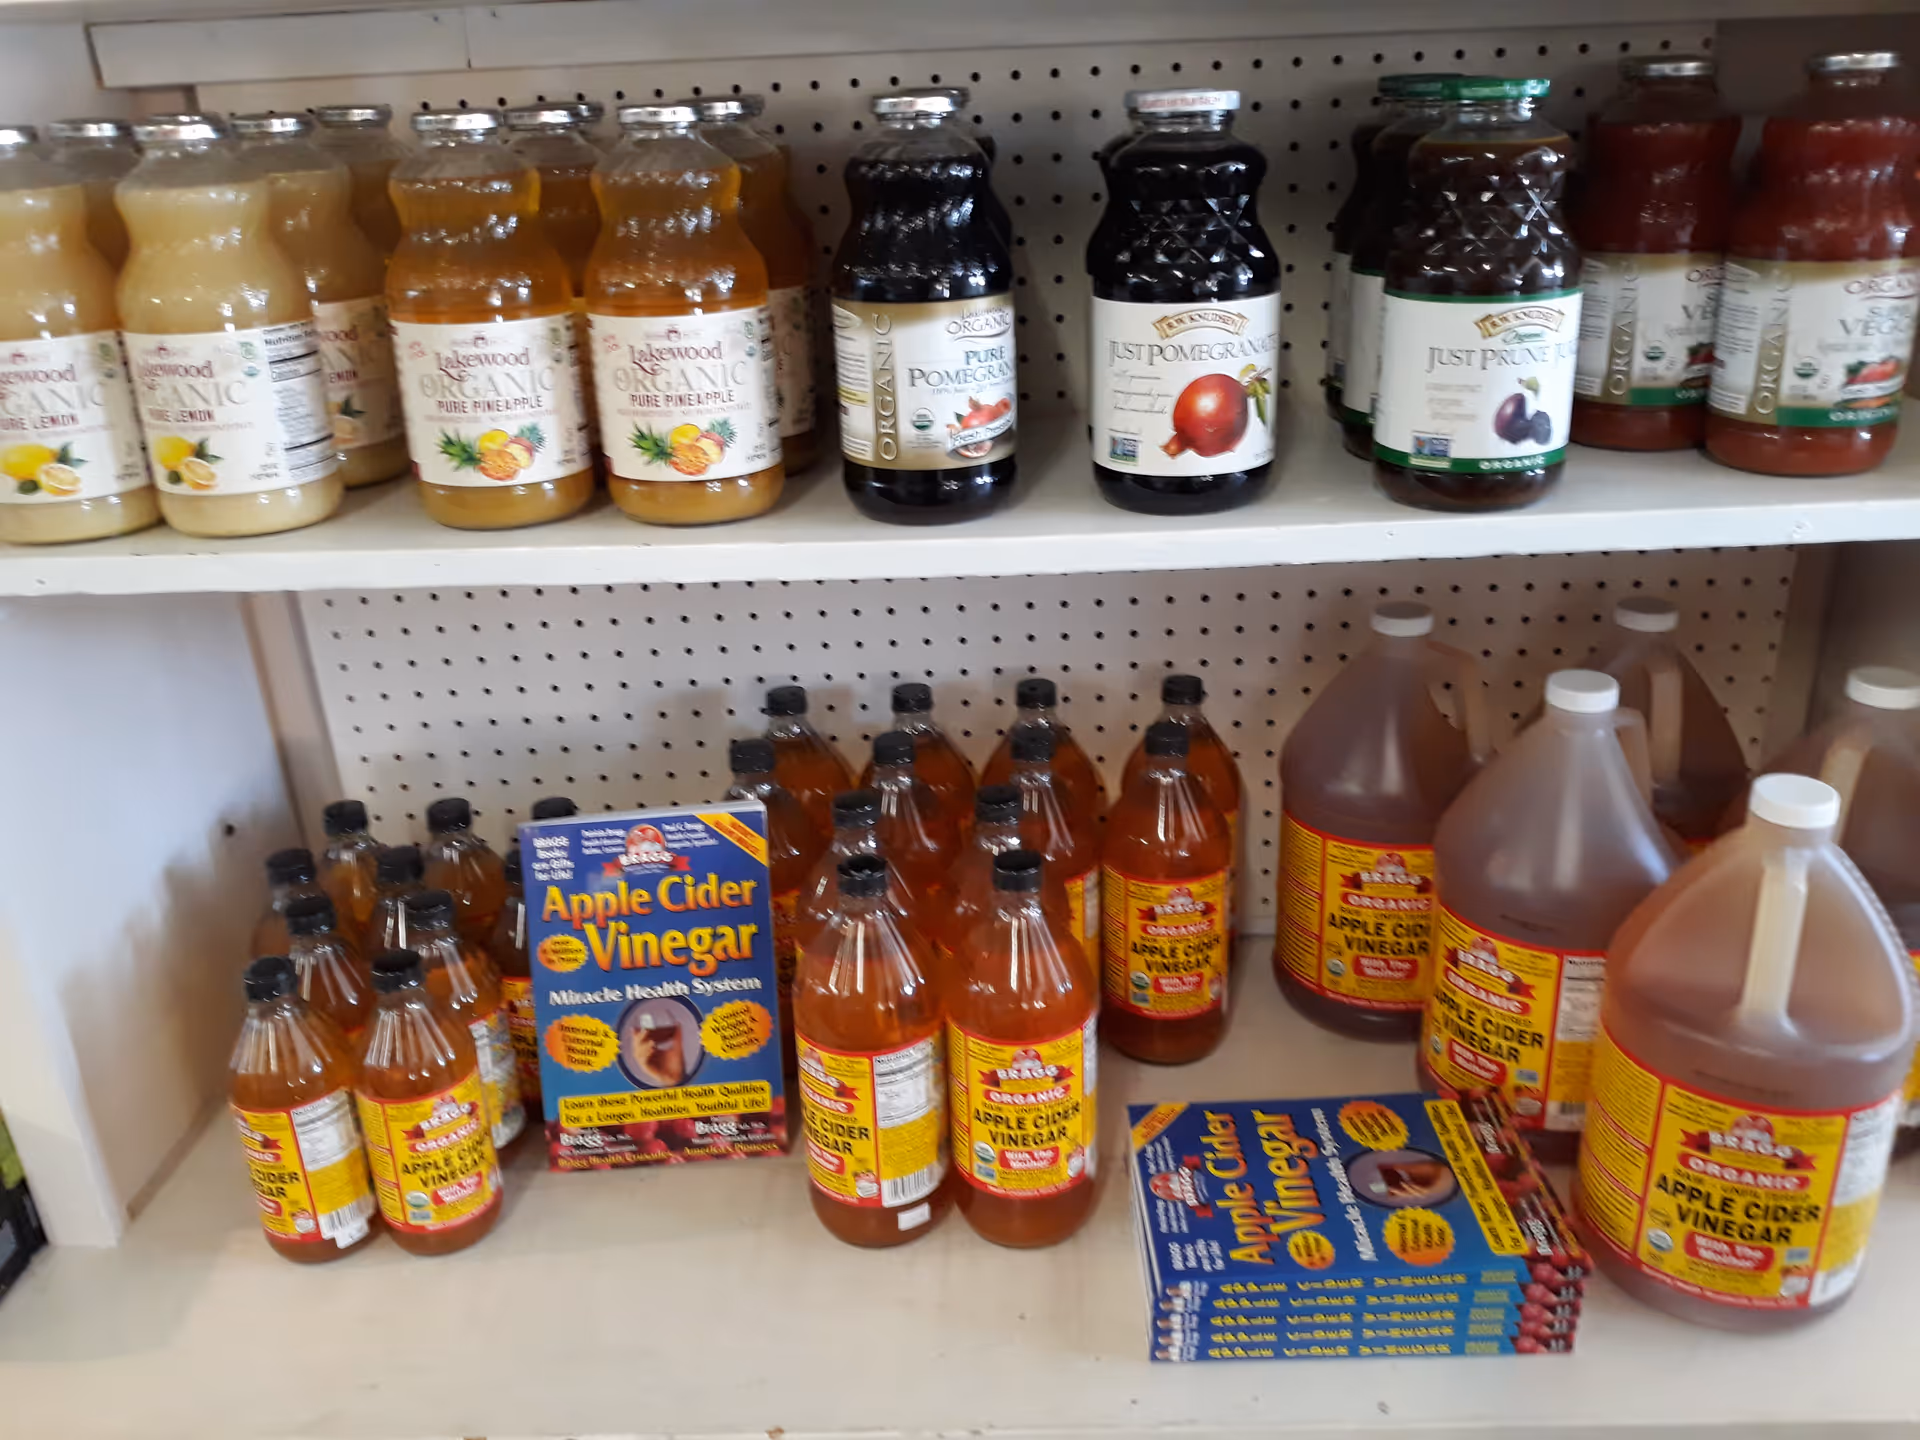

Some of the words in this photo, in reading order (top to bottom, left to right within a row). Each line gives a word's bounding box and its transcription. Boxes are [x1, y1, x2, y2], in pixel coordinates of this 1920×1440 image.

[436, 347, 531, 373] Lakewood
[628, 340, 724, 364] Lakewood
[965, 346, 1006, 365] PURE
[1109, 340, 1146, 367] JUST
[1425, 347, 1477, 373] JUST
[1480, 346, 1550, 371] PRUNE
[419, 366, 556, 400] ORGANIC
[614, 361, 747, 394] ORGANIC
[872, 313, 898, 461] ORGANIC
[437, 400, 470, 415] PURE
[472, 396, 544, 414] PINEAPPLE
[630, 393, 661, 408] PURE
[666, 390, 735, 408] PINEAPPLE
[617, 851, 674, 866] BRAGG
[541, 880, 653, 931] Apple
[657, 872, 758, 914] Cider
[1347, 894, 1432, 911] ORGANIC
[1146, 921, 1212, 936] ORGANIC
[1328, 912, 1387, 937] APPLE
[582, 920, 759, 978] Vinegar
[1131, 940, 1179, 960] APPLE
[1343, 934, 1430, 957] VINEGAR
[1143, 954, 1213, 973] VINEGAR
[549, 986, 624, 1006] Miracle
[625, 981, 690, 1000] Health
[691, 976, 763, 997] System
[1481, 1017, 1545, 1049] CIDER
[996, 1064, 1060, 1081] BRAGG
[681, 1087, 715, 1100] Health
[989, 1086, 1067, 1106] ORGANIC
[419, 1102, 473, 1131] BRAGG
[694, 1120, 739, 1136] Bragg
[820, 1117, 871, 1141] CIDER
[974, 1107, 1028, 1131] APPLE
[1033, 1101, 1081, 1131] CIDER
[415, 1119, 480, 1152] ORGANIC
[560, 1132, 604, 1148] Bragg
[988, 1125, 1067, 1148] VINEGAR
[1199, 1109, 1248, 1179] Cider
[1707, 1130, 1794, 1159] BRAGG
[255, 1168, 300, 1184] CIDER
[401, 1155, 451, 1176] APPLE
[419, 1154, 486, 1188] VINEGAR
[1250, 1108, 1326, 1234] Vinegar
[1687, 1155, 1801, 1191] ORGANIC
[1325, 1156, 1356, 1205] Health
[1655, 1173, 1736, 1216] APPLE
[1744, 1201, 1822, 1224] CIDER
[1215, 1182, 1281, 1266] Apple
[1344, 1204, 1379, 1262] Miracle
[1676, 1202, 1793, 1244] VINEGAR
